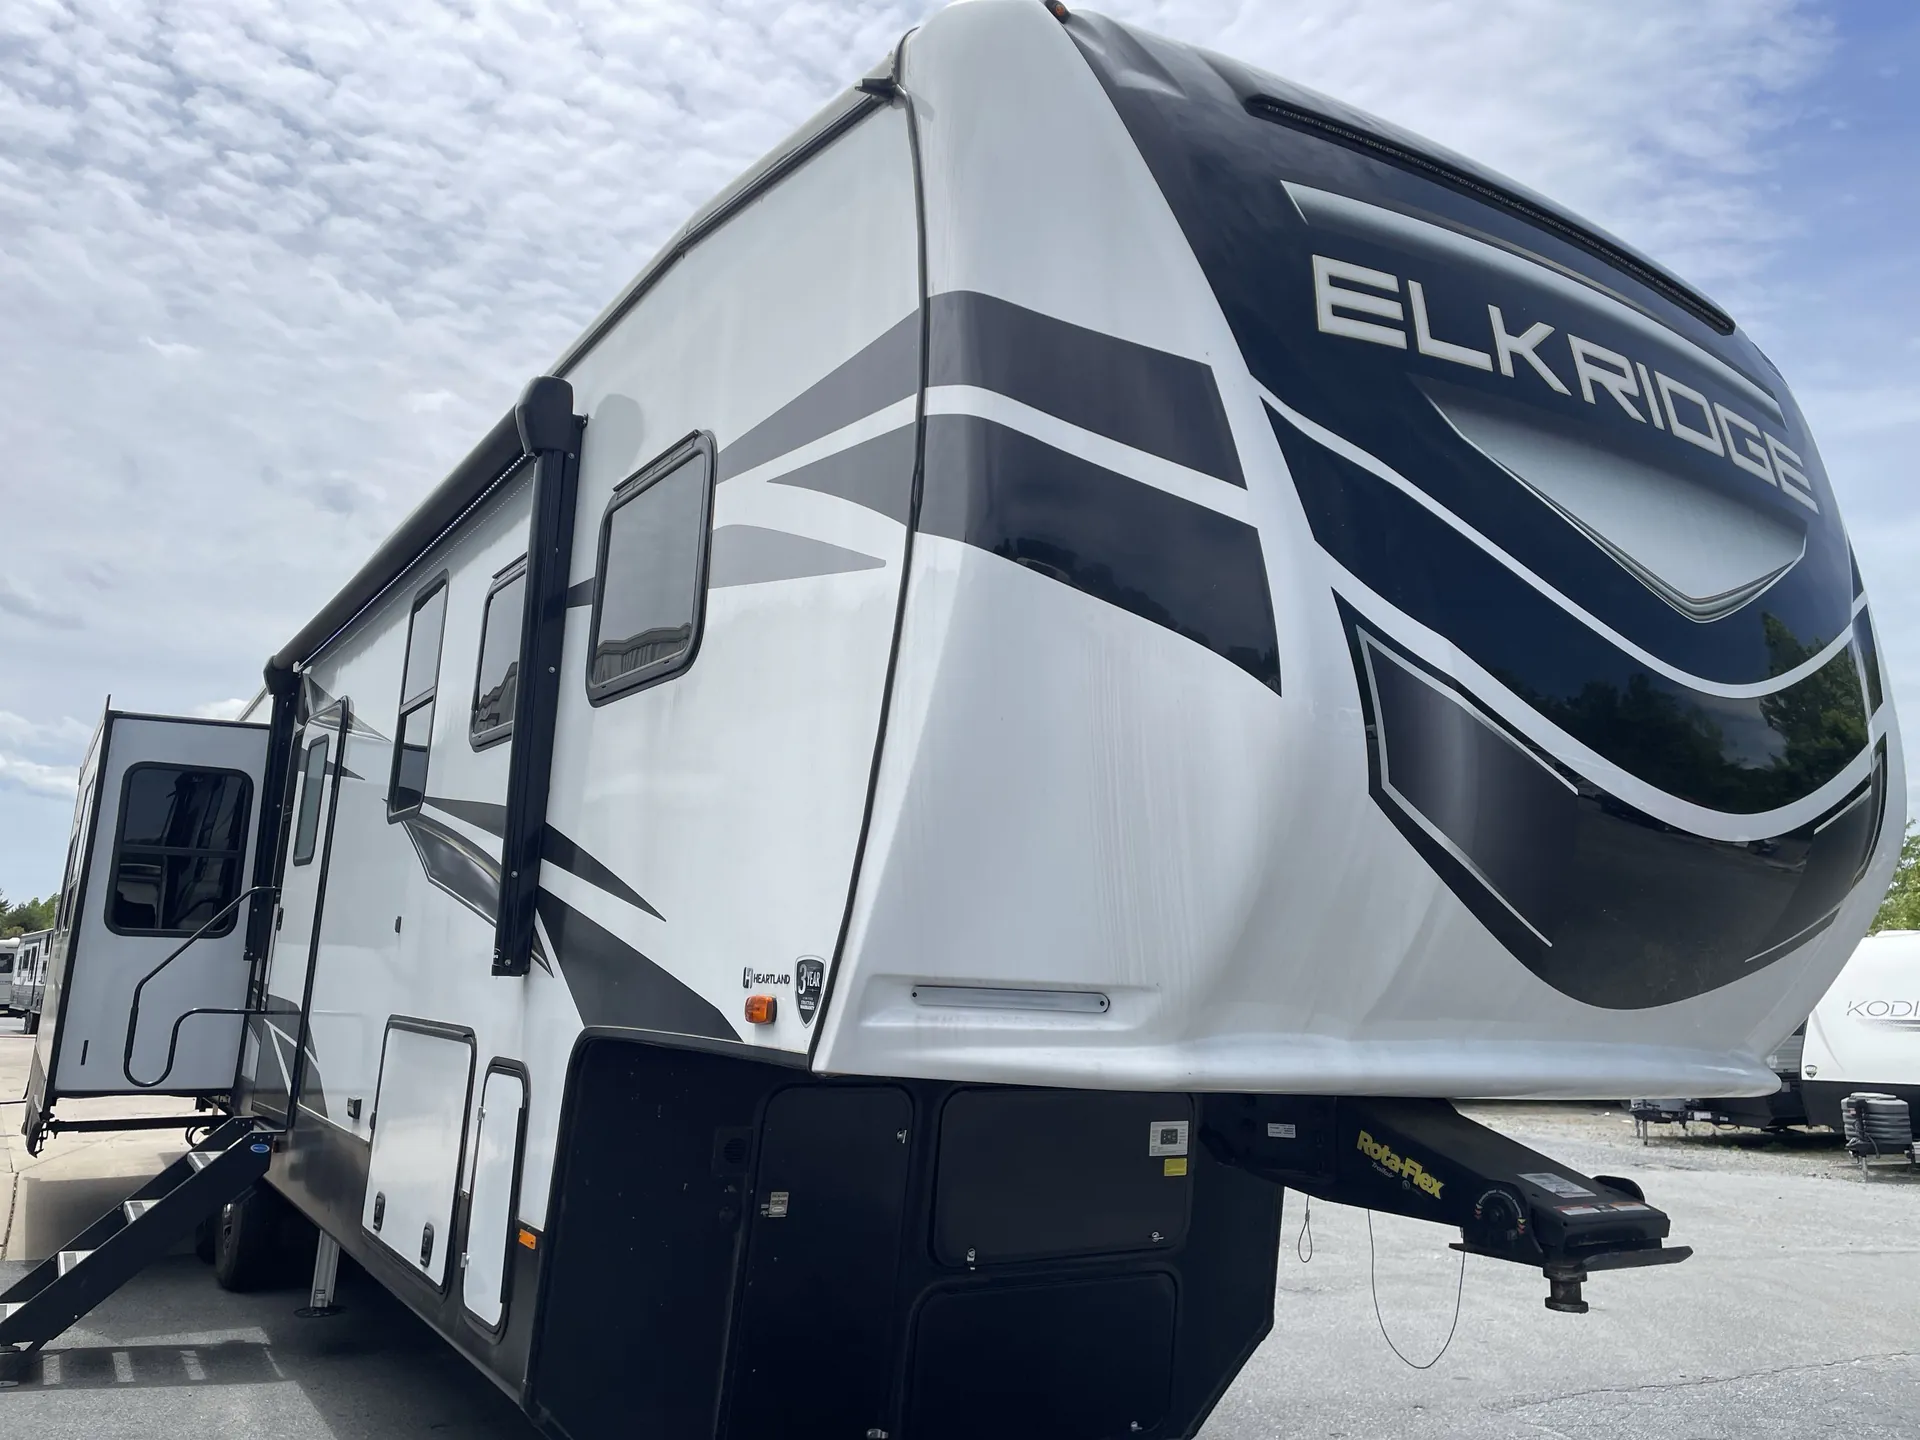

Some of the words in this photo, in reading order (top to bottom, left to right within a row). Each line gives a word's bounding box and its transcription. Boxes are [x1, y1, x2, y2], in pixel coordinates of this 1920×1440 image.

[1312, 254, 1819, 514] ELKRIDGE
[753, 973, 791, 985] HEARTLAND
[798, 963, 807, 995] 3
[806, 971, 821, 987] YEAR
